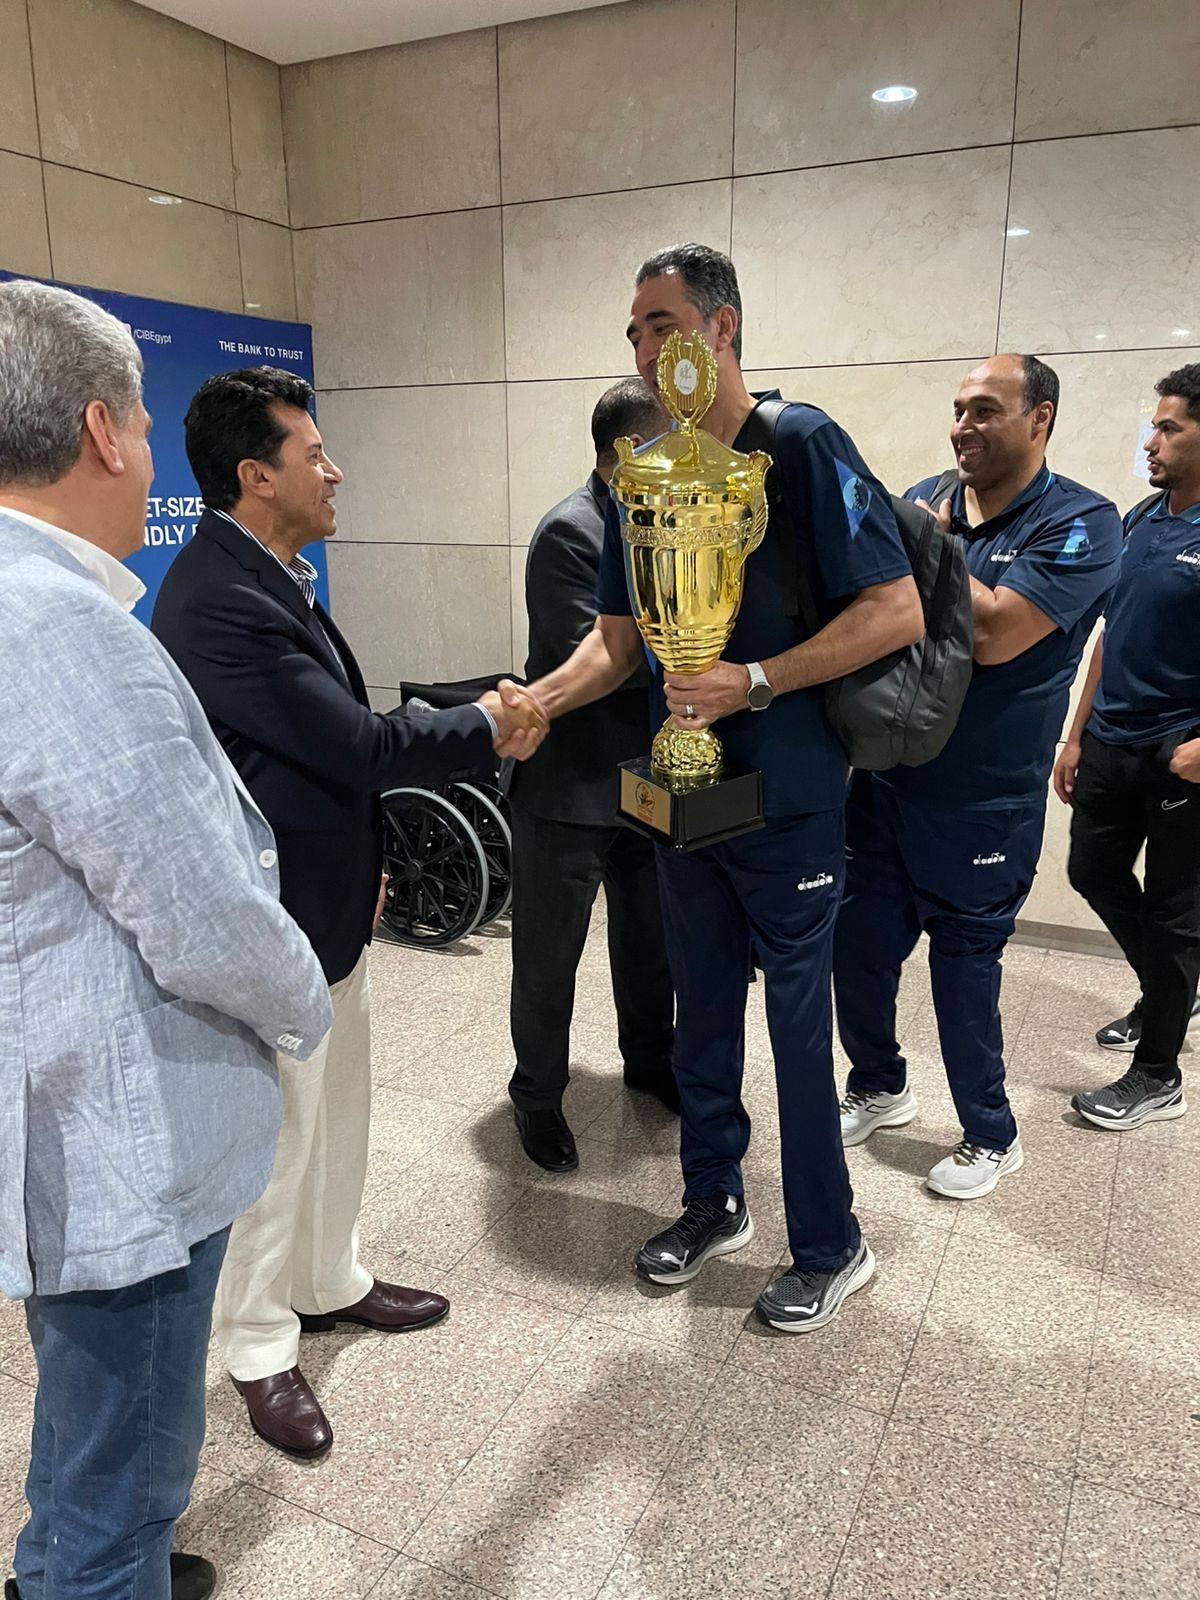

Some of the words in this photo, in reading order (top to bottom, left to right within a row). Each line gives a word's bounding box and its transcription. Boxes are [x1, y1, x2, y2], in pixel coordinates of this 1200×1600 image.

[133, 329, 172, 344] /CIBEgypt
[218, 340, 236, 352] THE
[238, 343, 262, 355] BANK
[264, 346, 276, 357] TO
[277, 348, 304, 360] TRUST
